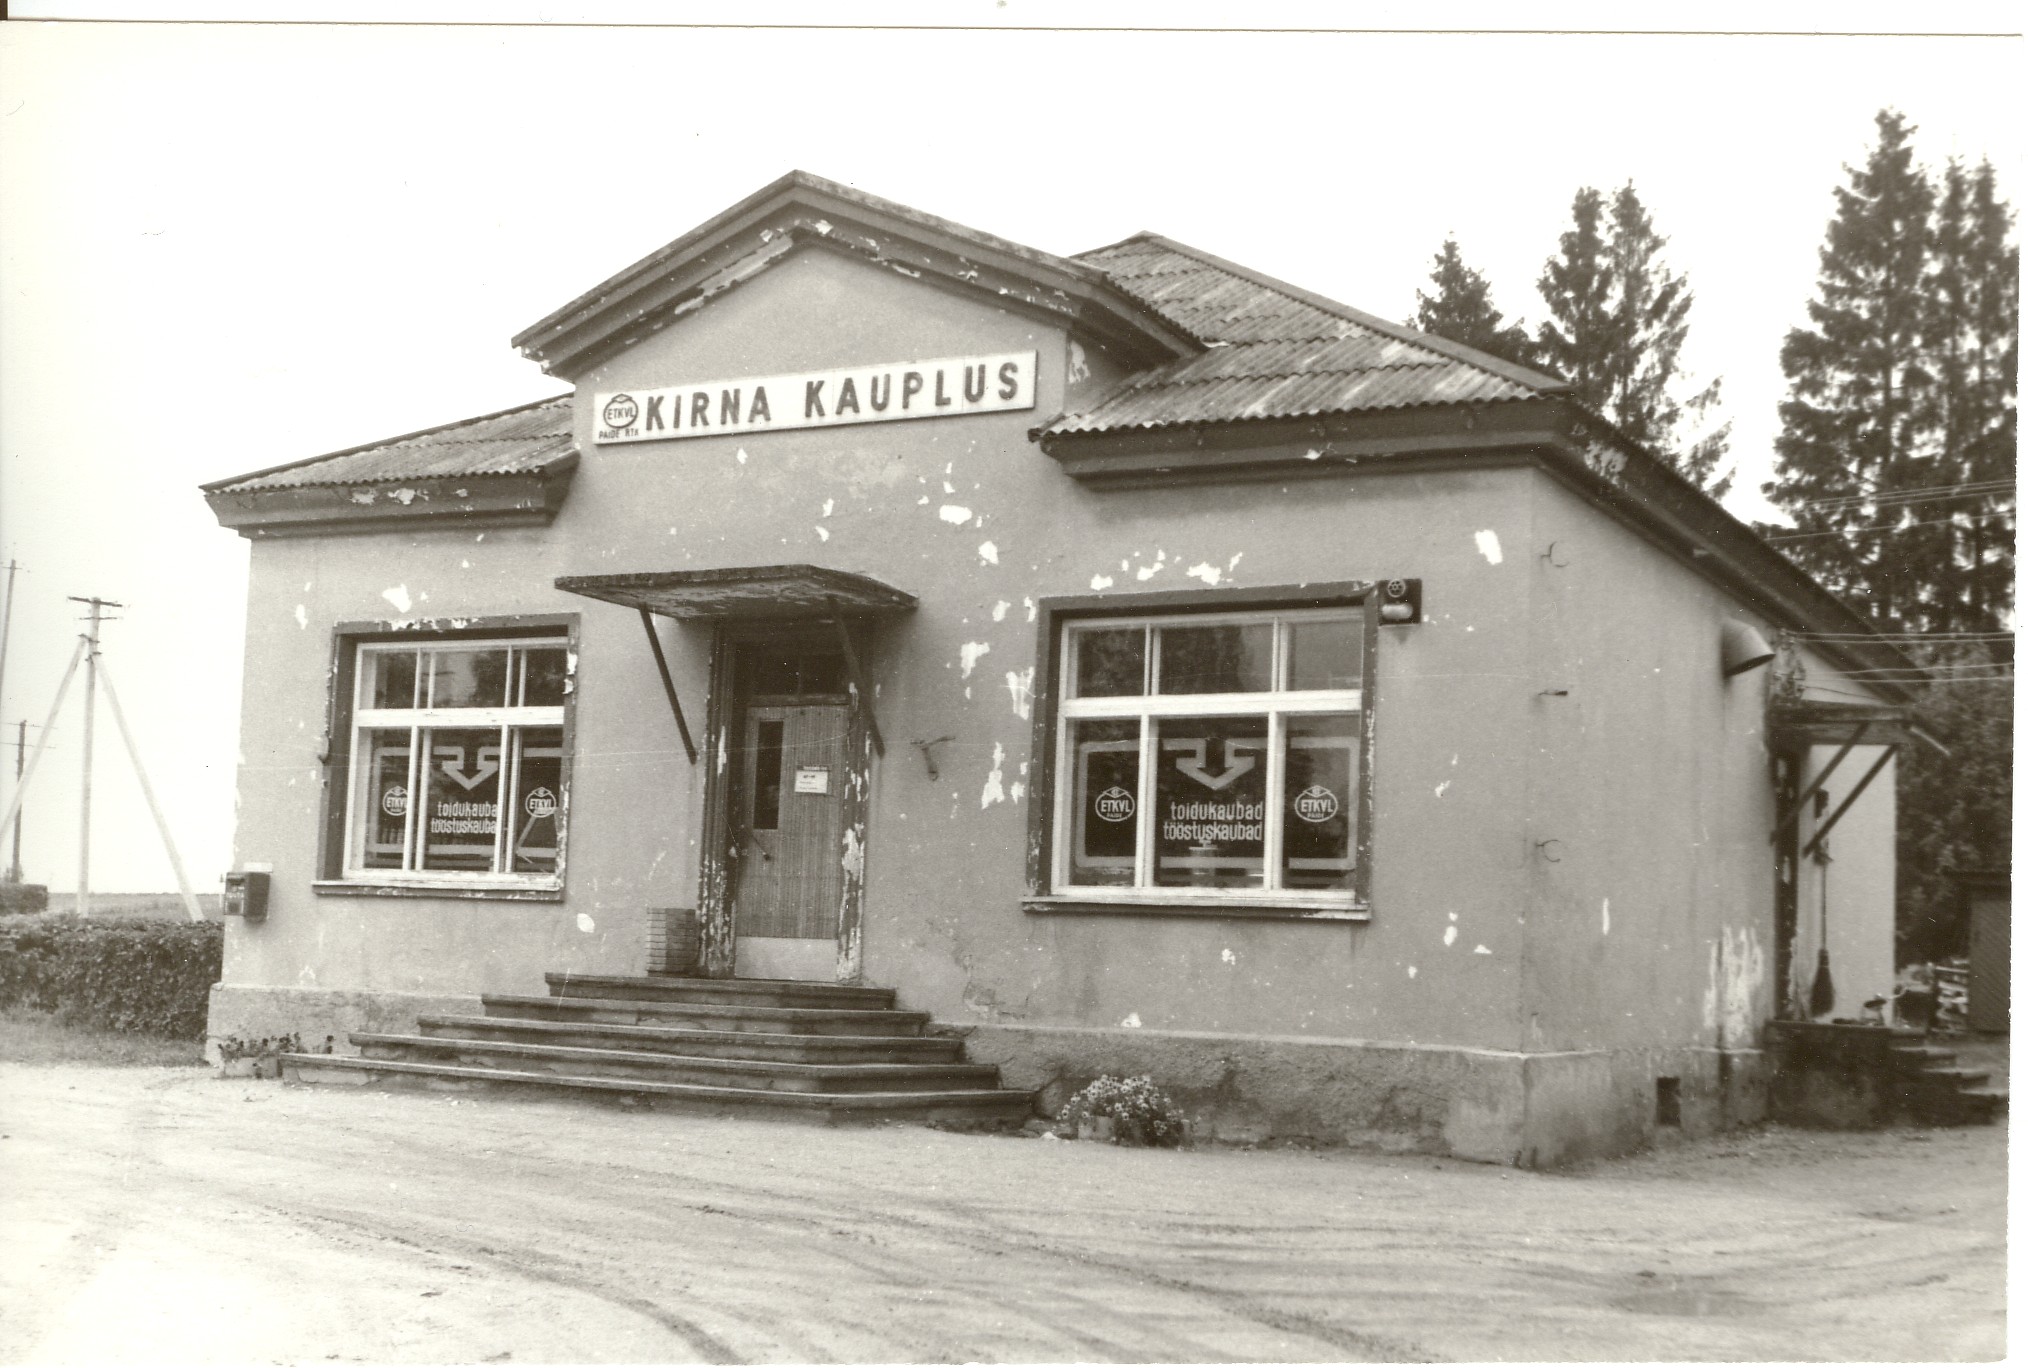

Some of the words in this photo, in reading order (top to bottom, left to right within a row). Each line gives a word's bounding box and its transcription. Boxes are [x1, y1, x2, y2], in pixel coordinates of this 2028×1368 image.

[645, 386, 771, 431] KIRNA
[804, 361, 1020, 418] KAUPLUS
[607, 407, 635, 420] ETKVL
[437, 801, 497, 817] toidukauba
[1101, 799, 1131, 813] ETKVL
[1170, 801, 1263, 821] toidukaubad
[1300, 799, 1334, 813] ETKVL
[431, 818, 497, 833] tööstuskauba
[1163, 821, 1263, 841] tööstuskaubad
